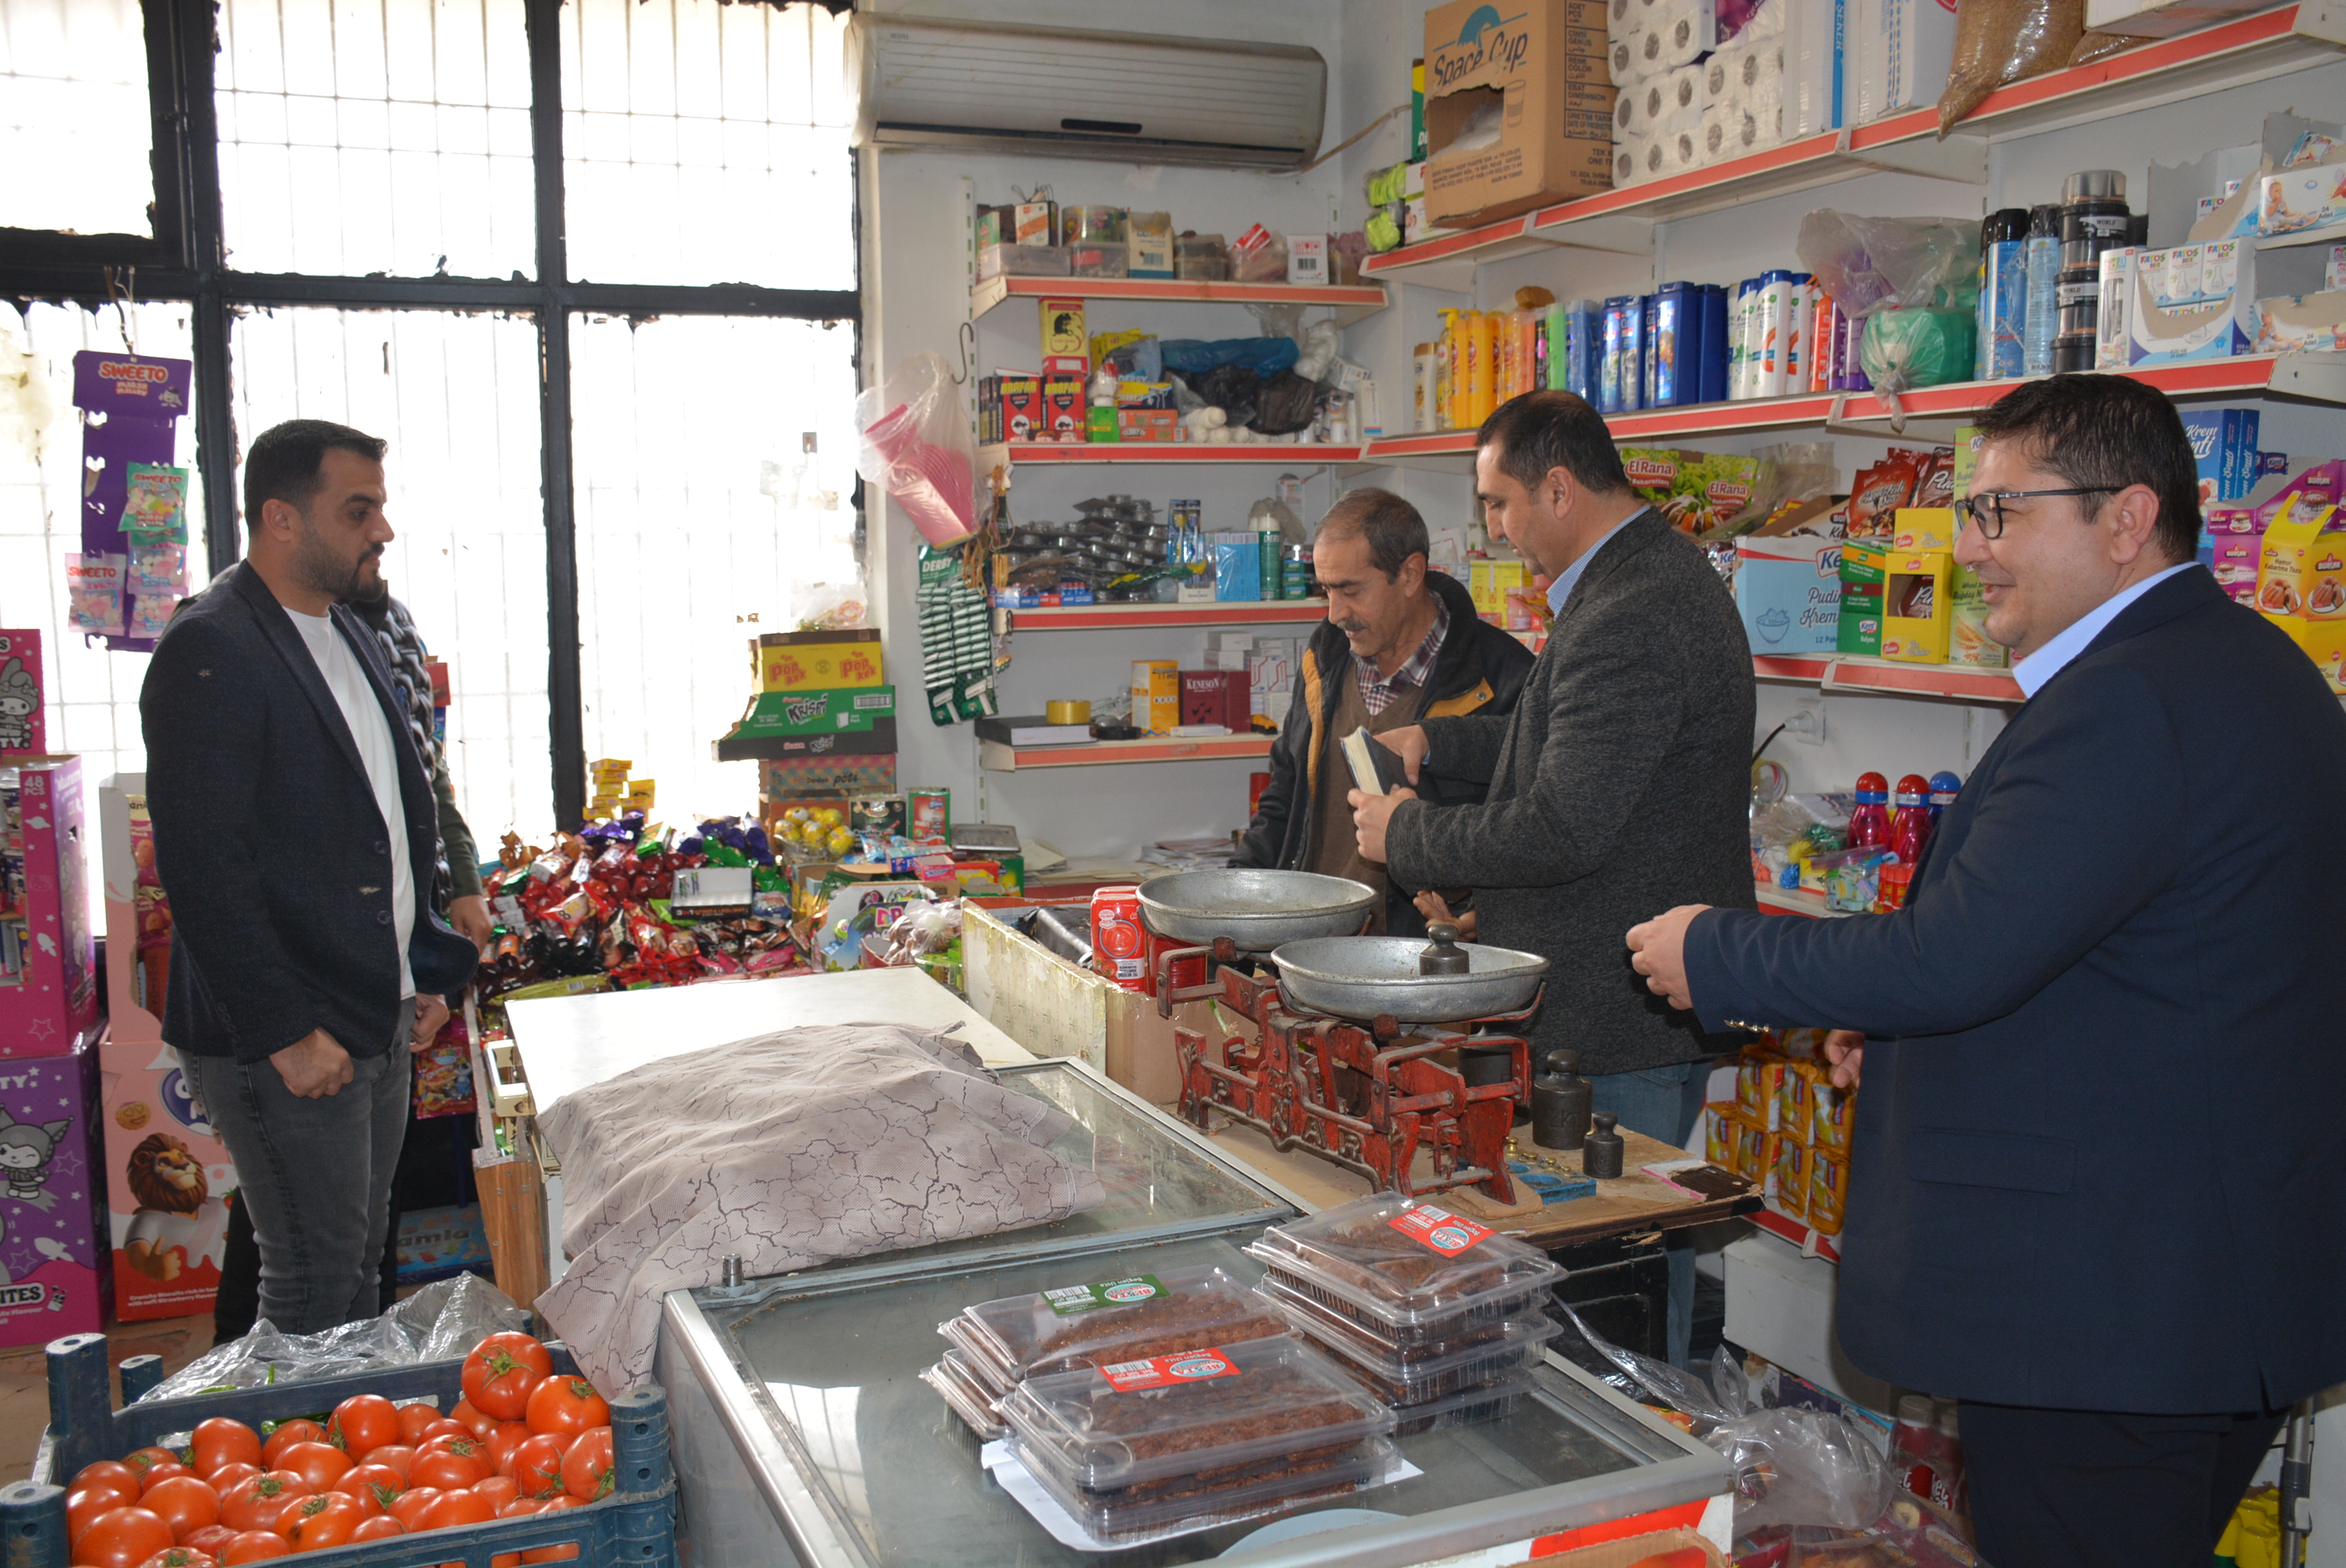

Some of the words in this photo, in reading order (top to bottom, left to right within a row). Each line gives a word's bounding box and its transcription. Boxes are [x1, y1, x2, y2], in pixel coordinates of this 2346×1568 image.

[1435, 49, 1484, 85] Space
[1489, 31, 1528, 73] Cup
[1569, 92, 1606, 101] DIMENSION
[1588, 157, 1603, 165] ONE
[99, 361, 168, 383] SWEETO
[2186, 424, 2218, 441] Krem
[922, 557, 953, 572] DERBY
[68, 566, 116, 578] SWEETO
[1799, 608, 1837, 629] Krem
[25, 775, 44, 787] 48
[24, 786, 45, 796] PCS
